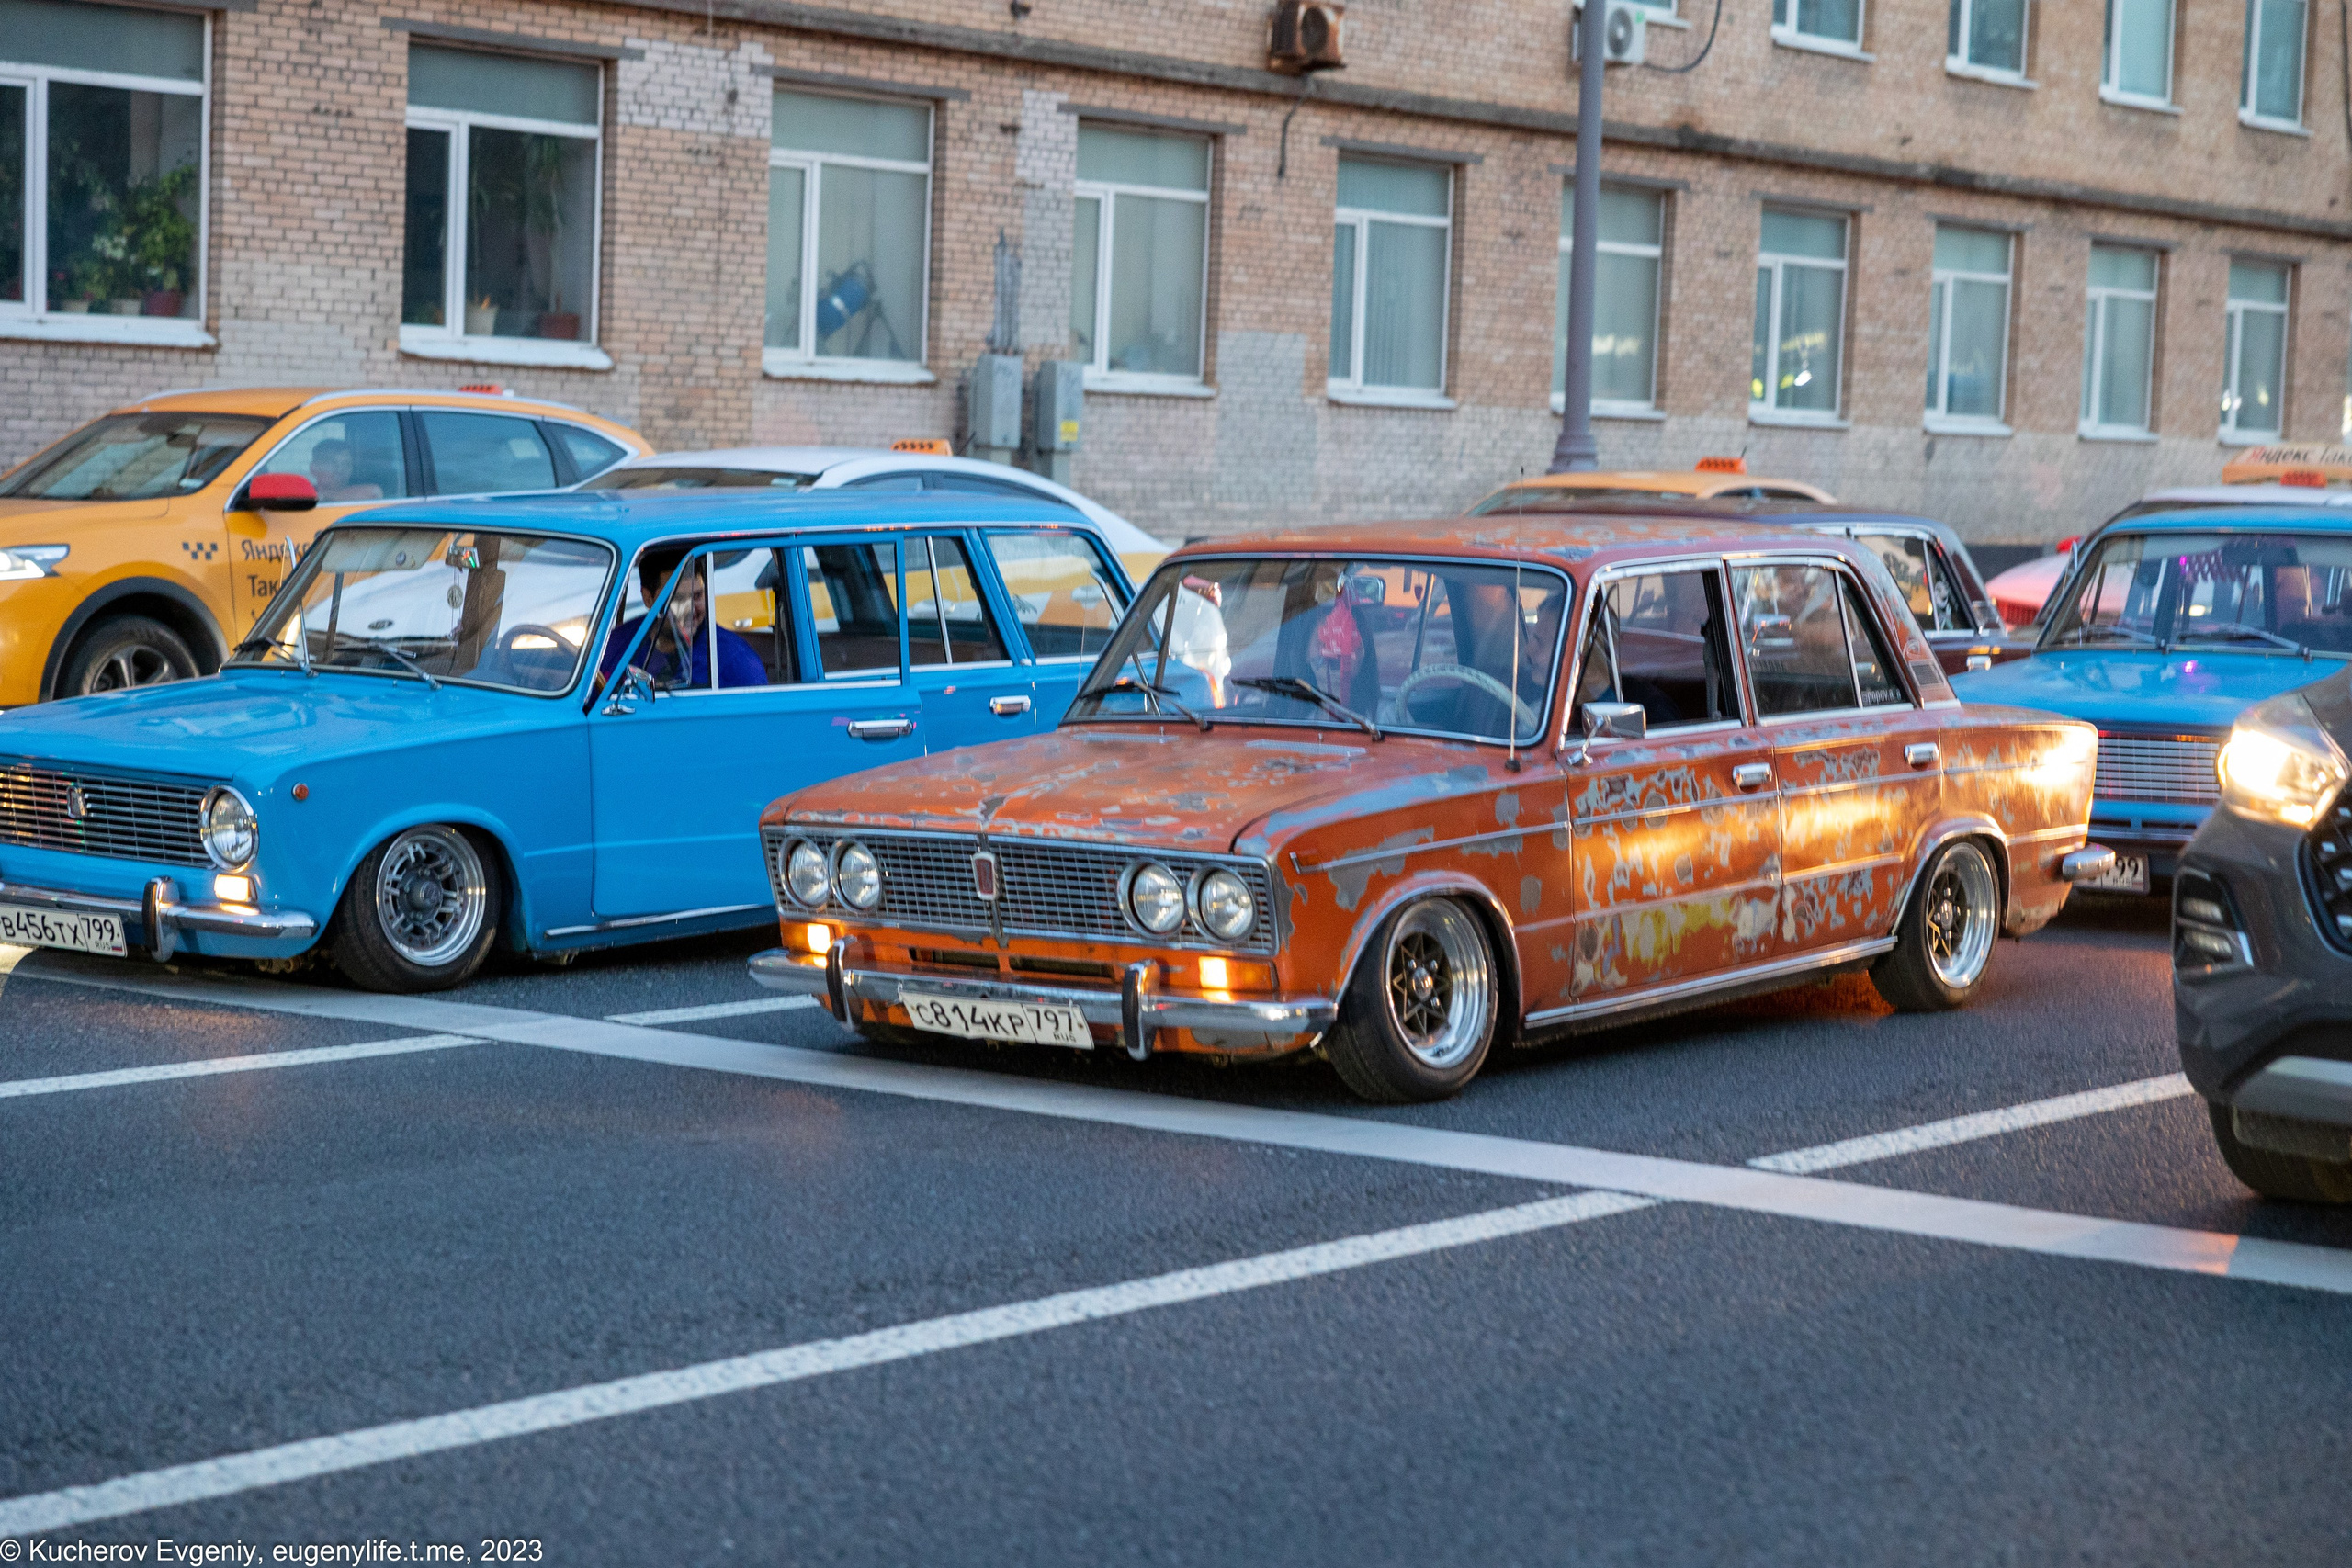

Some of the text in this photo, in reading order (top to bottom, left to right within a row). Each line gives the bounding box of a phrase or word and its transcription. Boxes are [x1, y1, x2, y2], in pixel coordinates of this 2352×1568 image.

[2105, 856, 2139, 878] 99
[80, 917, 115, 942] 799
[95, 940, 111, 951] RUS
[1027, 1008, 1074, 1032] 797
